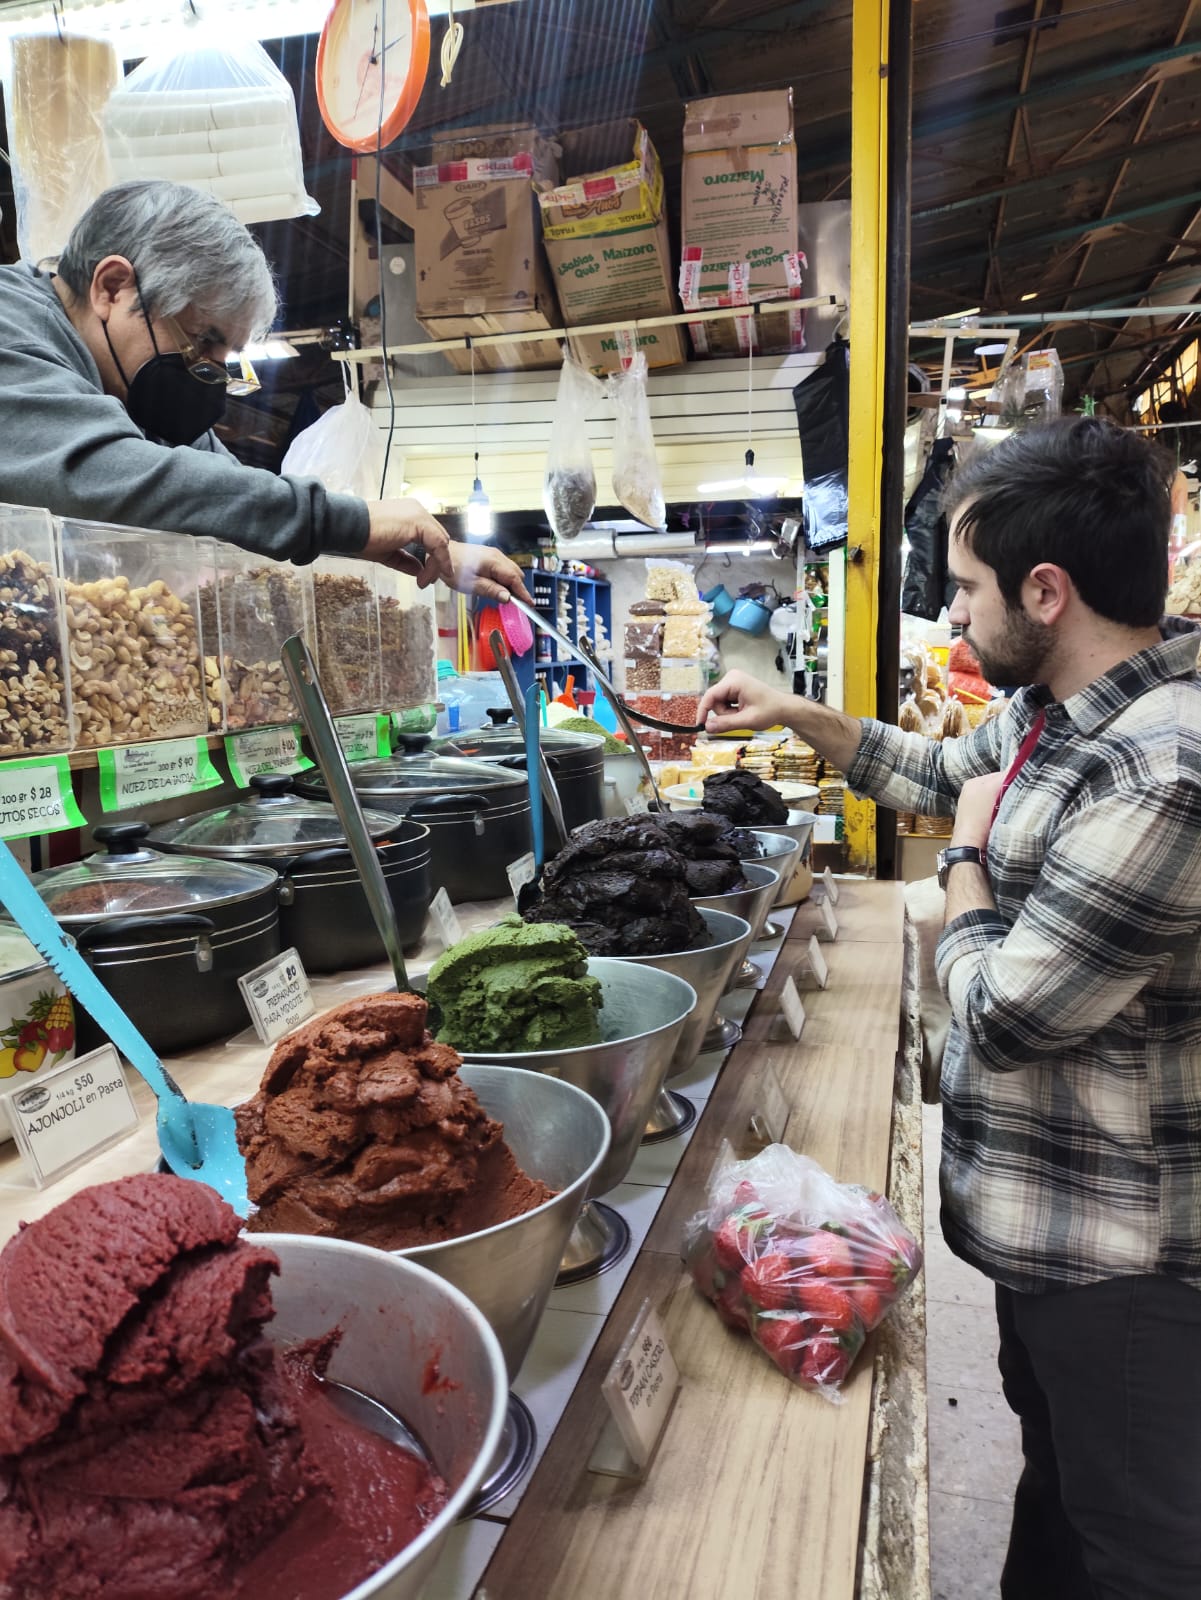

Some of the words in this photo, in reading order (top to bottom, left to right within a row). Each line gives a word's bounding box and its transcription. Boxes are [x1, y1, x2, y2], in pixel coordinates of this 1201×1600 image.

[122, 782, 147, 795] NUEZ
[148, 779, 159, 790] DE
[160, 778, 172, 788] LA
[173, 774, 197, 786] INDIA
[2, 794, 17, 804] 100
[19, 793, 27, 803] gr
[30, 787, 37, 801] $
[40, 786, 52, 800] 28
[28, 803, 60, 820] SECOS
[266, 981, 300, 1008] PREPARADO
[264, 1010, 281, 1027] PARA
[74, 1073, 94, 1091] $50
[28, 1097, 86, 1136] AJONJOLI
[86, 1092, 97, 1104] en
[97, 1078, 123, 1100] Pasta
